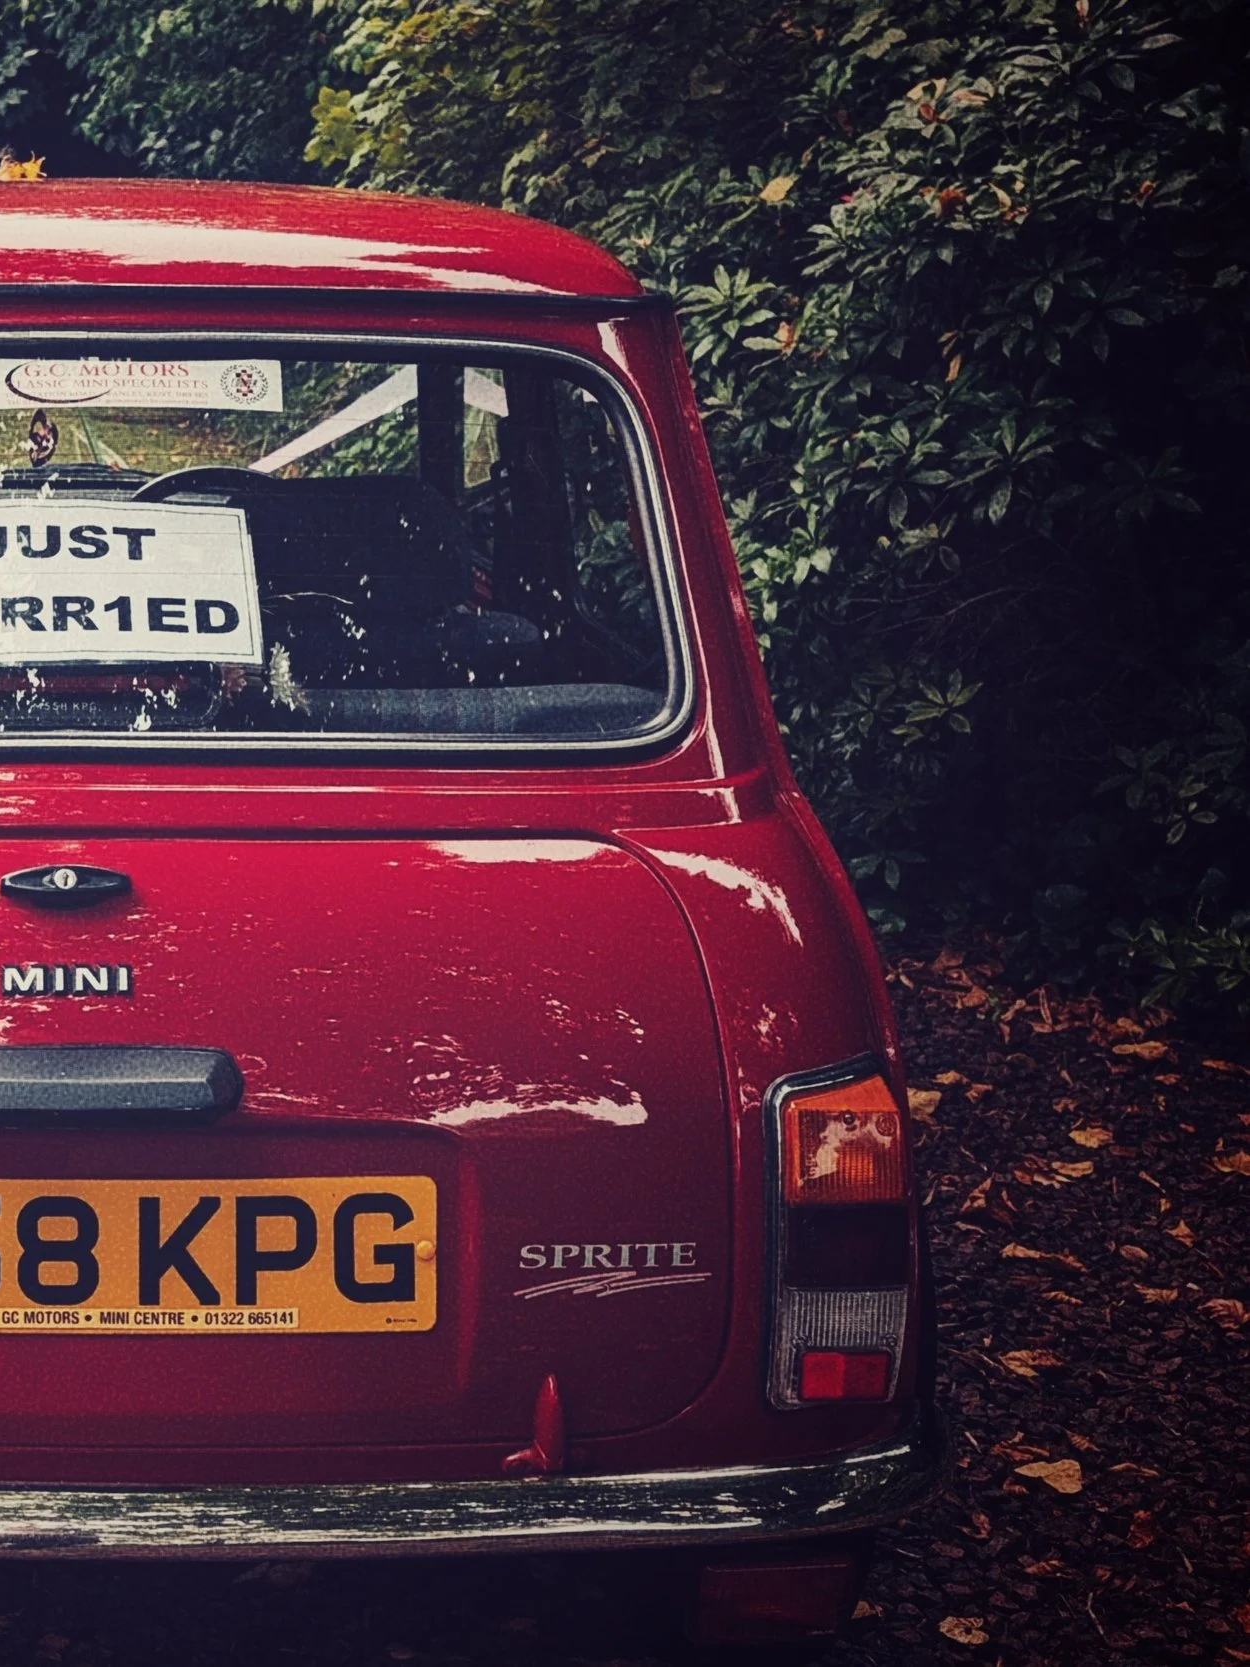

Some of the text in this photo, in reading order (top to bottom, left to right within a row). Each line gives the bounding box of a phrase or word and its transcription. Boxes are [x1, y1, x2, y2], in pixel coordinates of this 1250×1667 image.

[24, 363, 189, 377] G.C. MOTORS
[16, 379, 209, 389] LASSIC MINI SPECIALISTS
[2, 965, 130, 993] MINI
[138, 1192, 417, 1306] KPG
[519, 1242, 697, 1269] SPRITE
[1, 1311, 20, 1324] GC
[24, 1311, 80, 1324] MOTORS
[100, 1311, 130, 1325] MINI
[134, 1311, 185, 1325] CENTRE
[204, 1311, 245, 1325] 01322
[248, 1311, 294, 1325] 665141
